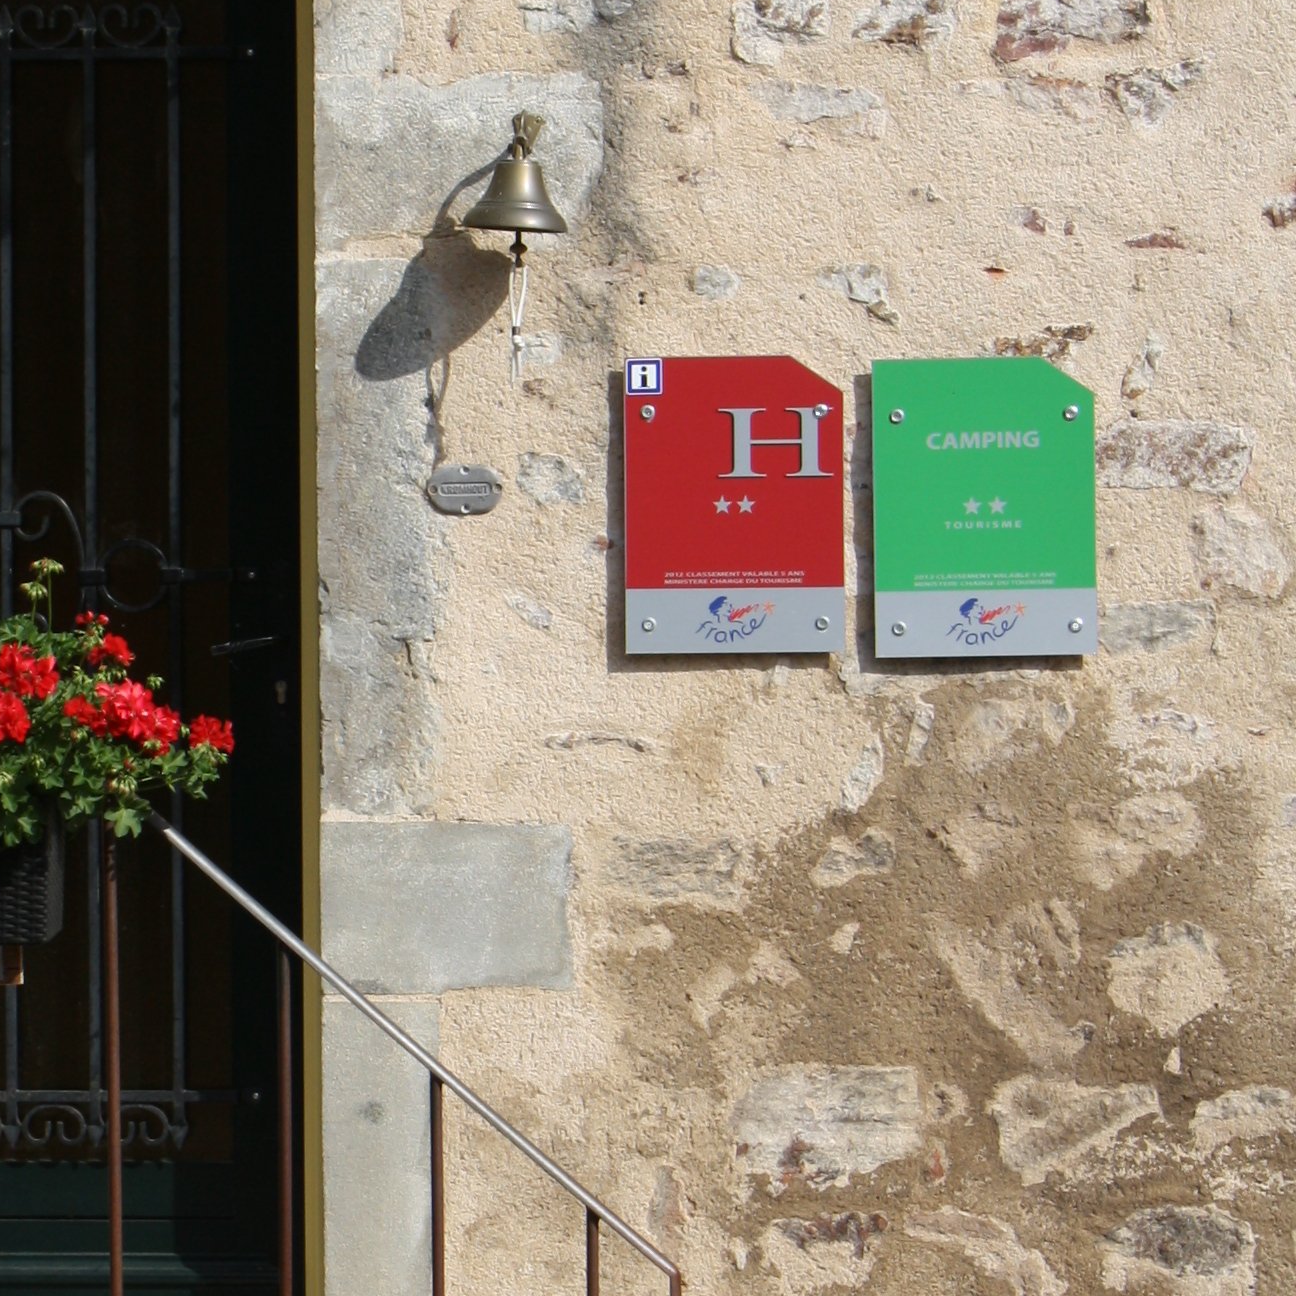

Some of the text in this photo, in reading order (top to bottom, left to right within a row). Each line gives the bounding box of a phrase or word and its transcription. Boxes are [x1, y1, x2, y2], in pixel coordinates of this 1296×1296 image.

[717, 407, 835, 478] H
[926, 430, 1041, 450] CAMPING
[944, 520, 1023, 529] TOURISME
